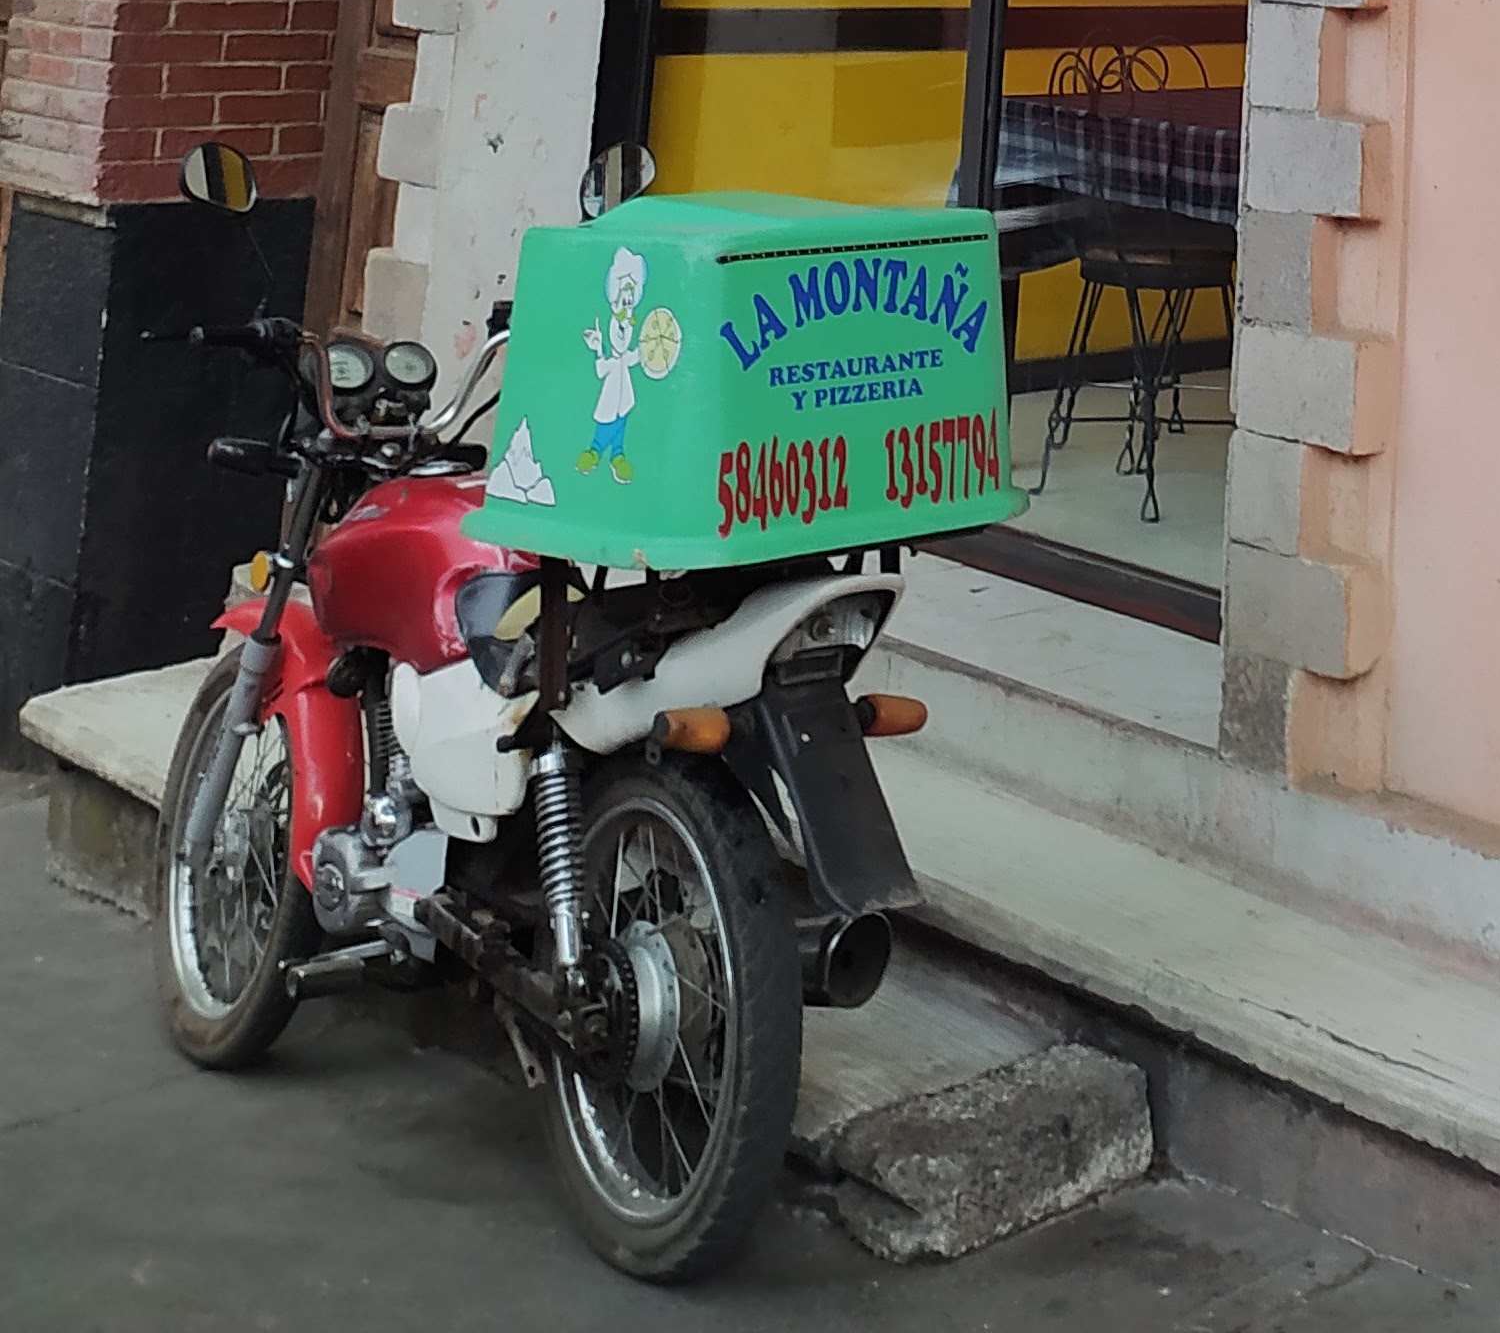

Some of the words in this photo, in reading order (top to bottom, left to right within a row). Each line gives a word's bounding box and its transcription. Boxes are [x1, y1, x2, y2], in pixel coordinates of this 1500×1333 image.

[720, 293, 788, 371] LA
[788, 258, 988, 353] MONTAÑA
[769, 349, 944, 387] RESTAURANTE
[792, 392, 809, 411] Y
[815, 377, 923, 408] PIZZERIA
[718, 435, 849, 539] 58460312
[885, 409, 999, 509] 13157794
